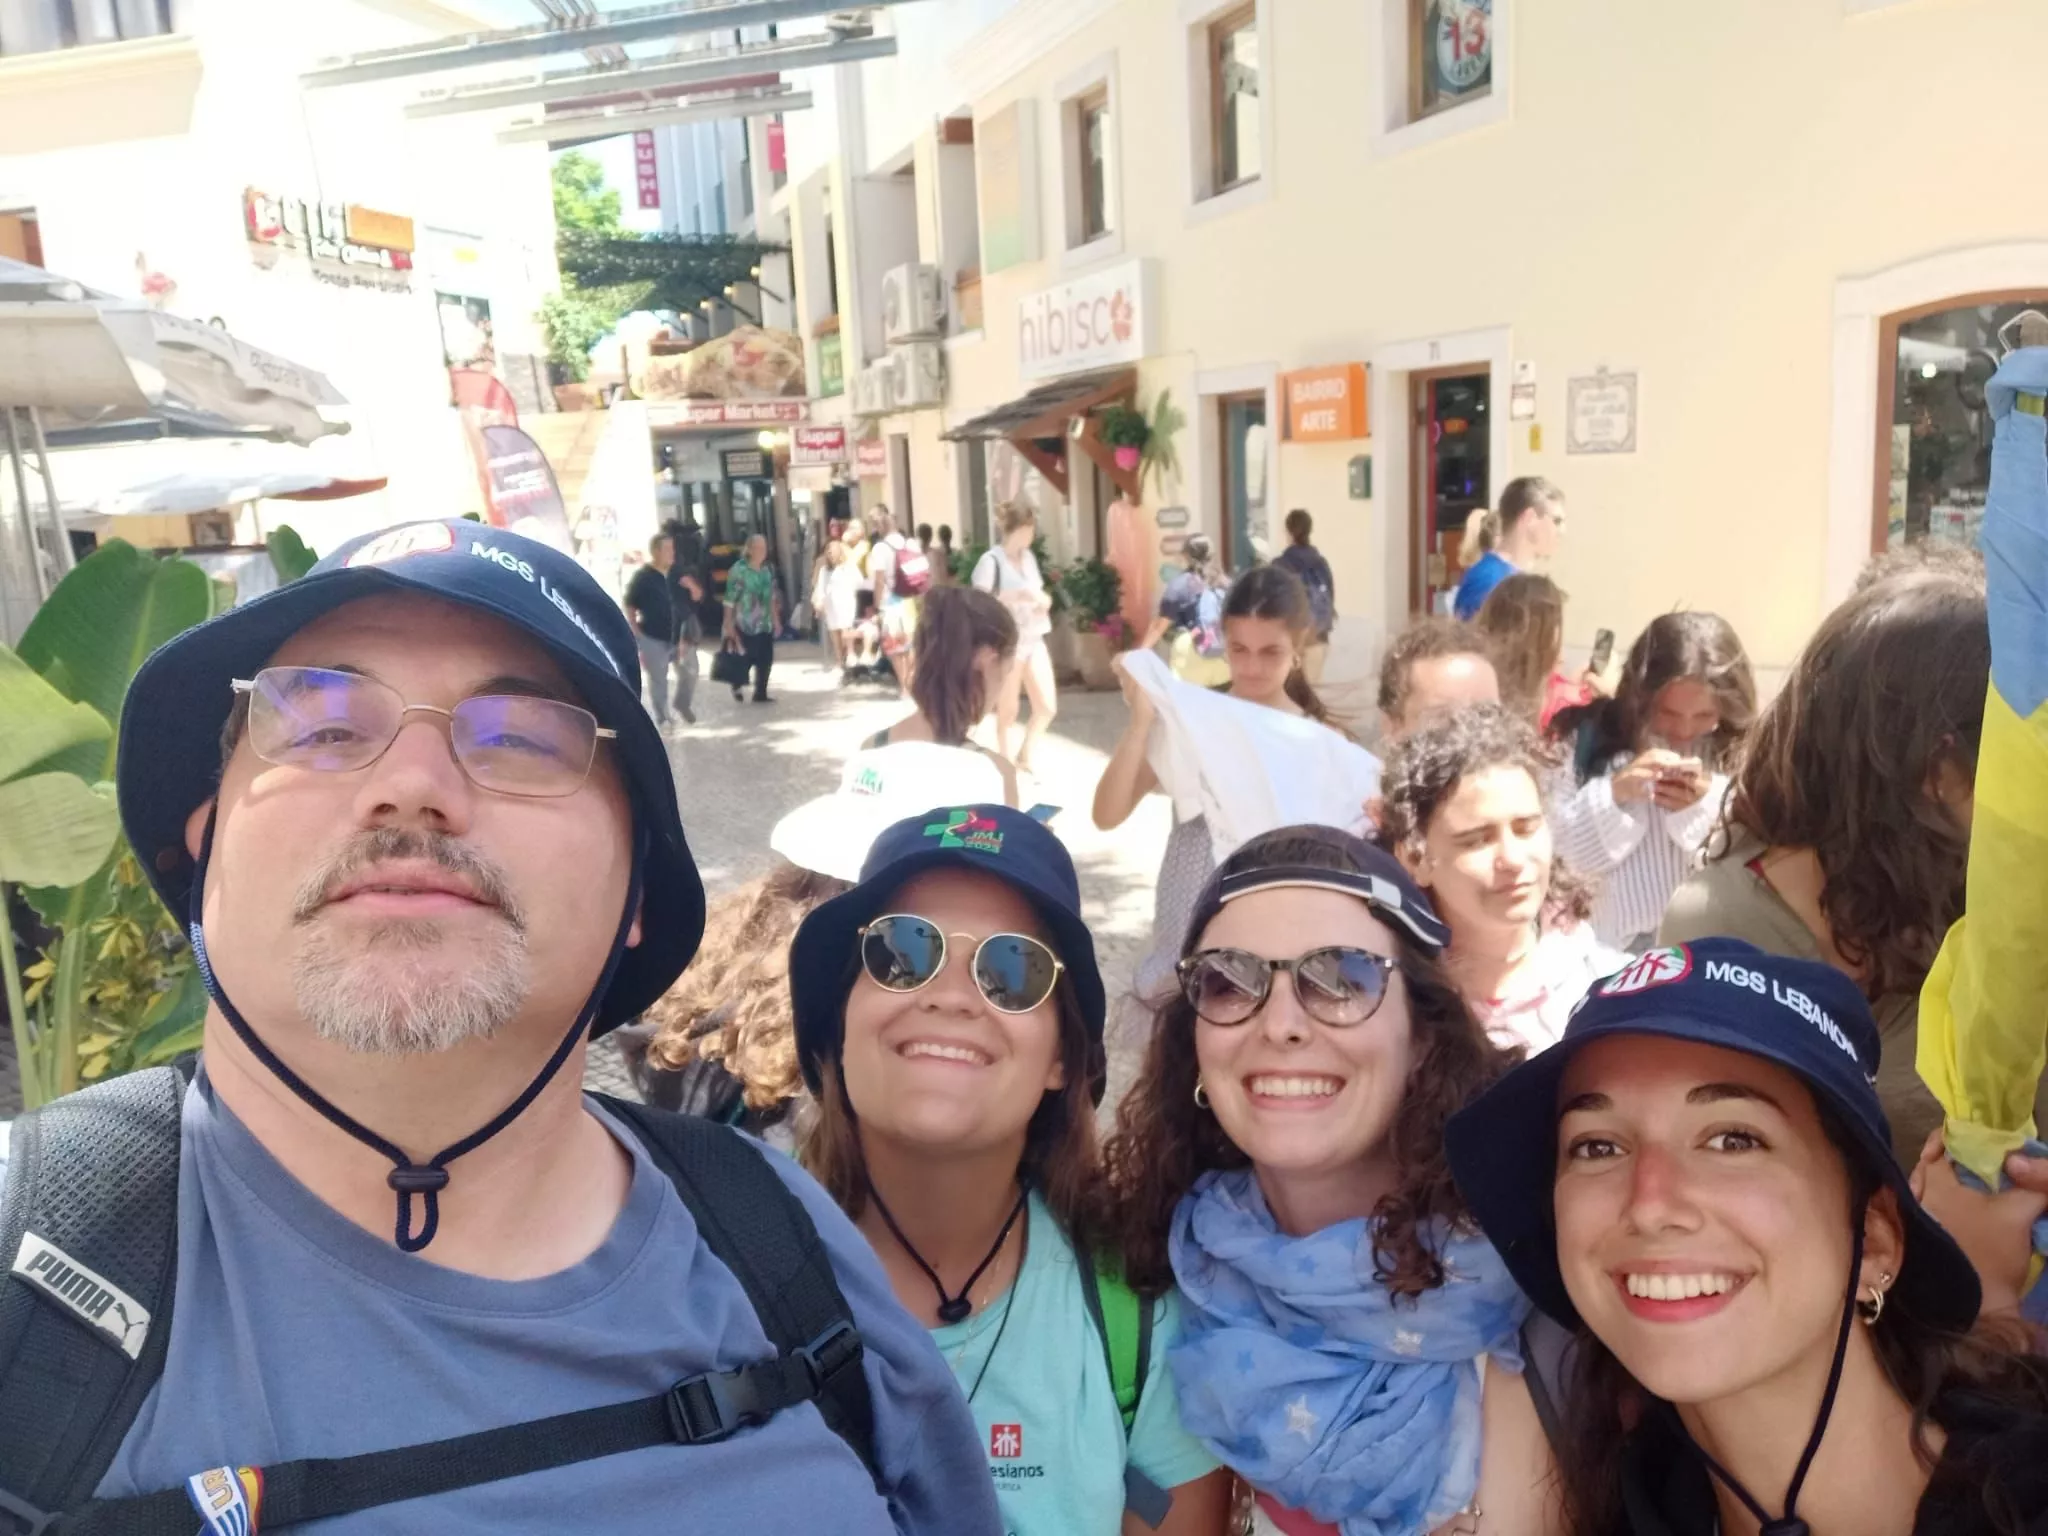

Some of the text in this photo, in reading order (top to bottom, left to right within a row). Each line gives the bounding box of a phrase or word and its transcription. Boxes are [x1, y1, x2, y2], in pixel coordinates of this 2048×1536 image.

[637, 131, 658, 205] SUSHI
[1293, 377, 1346, 403] BAIRRO
[684, 404, 722, 424] uper
[1300, 409, 1337, 432] ARTE
[798, 429, 841, 447] Super
[470, 541, 535, 583] MGS
[1705, 960, 1767, 995] MGS
[25, 1249, 116, 1319] PUMA
[991, 1463, 1044, 1479] esianos
